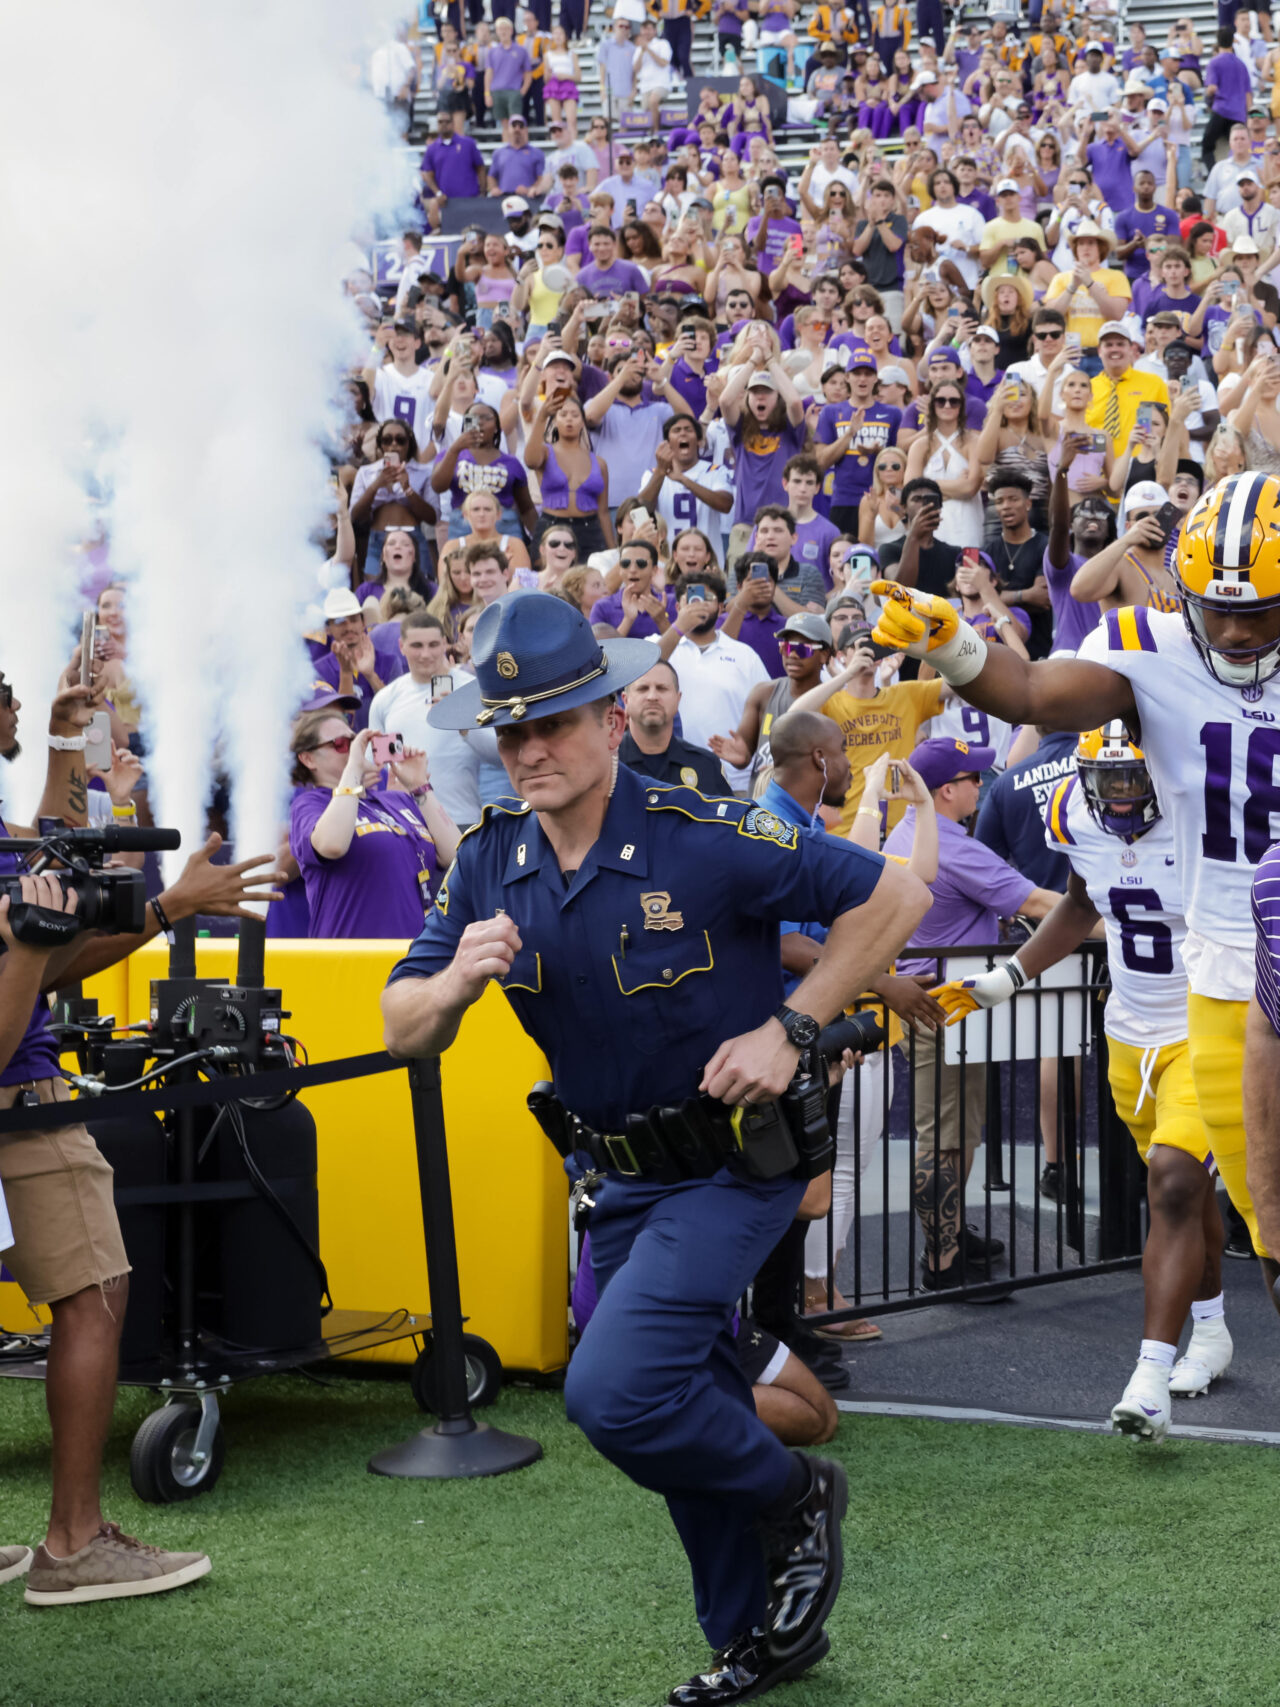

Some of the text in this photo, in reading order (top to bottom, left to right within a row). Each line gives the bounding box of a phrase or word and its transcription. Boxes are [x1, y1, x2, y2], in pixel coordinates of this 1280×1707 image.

[384, 249, 436, 281] 27
[674, 493, 698, 541] 9
[1215, 585, 1242, 598] LSU
[1242, 708, 1276, 723] LSU
[962, 707, 990, 749] 9
[1103, 750, 1123, 759] LSU
[1013, 756, 1077, 791] LANDMA
[1120, 876, 1143, 886] LSU
[39, 920, 68, 933] SONY
[1108, 887, 1175, 975] 6
